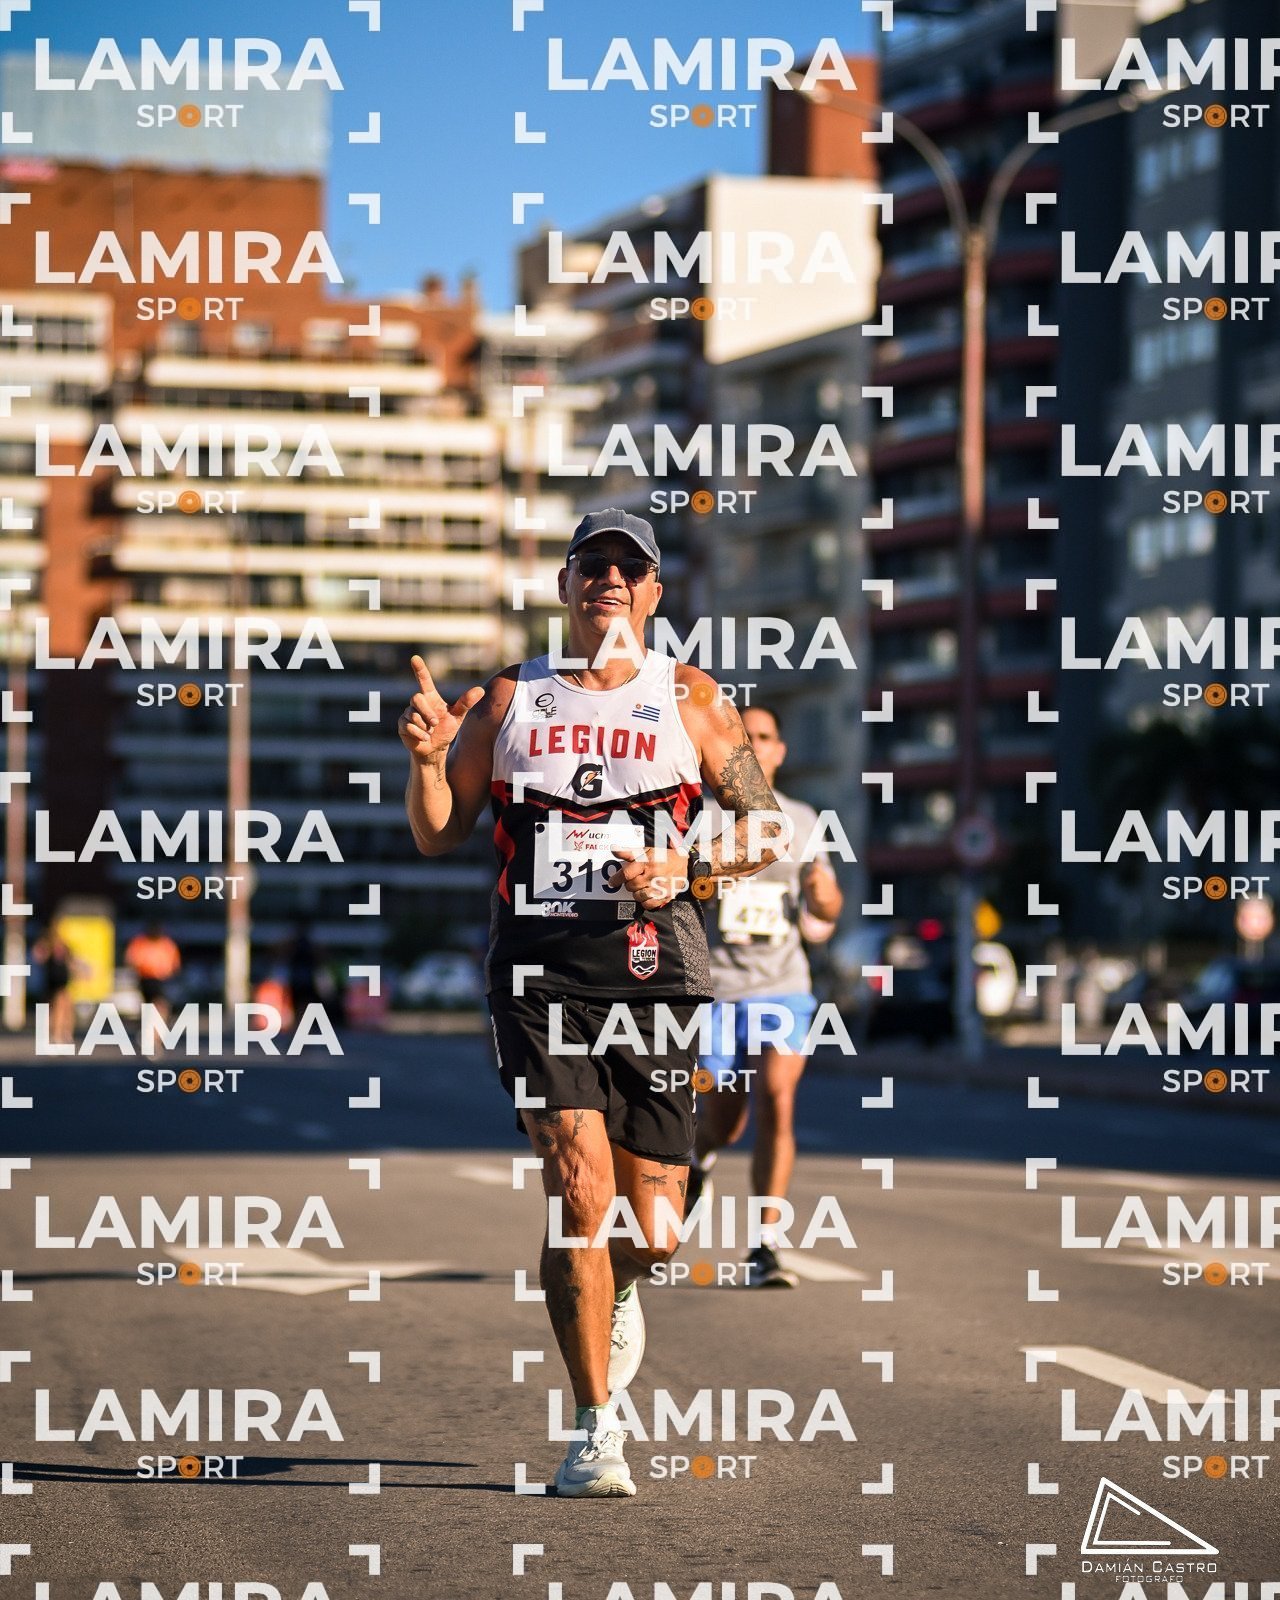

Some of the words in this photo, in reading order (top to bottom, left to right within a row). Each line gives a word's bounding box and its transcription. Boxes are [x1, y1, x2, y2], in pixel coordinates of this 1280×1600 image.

[529, 724, 656, 762] LEGION
[552, 858, 622, 894] 319
[632, 949, 657, 958] LEGION
